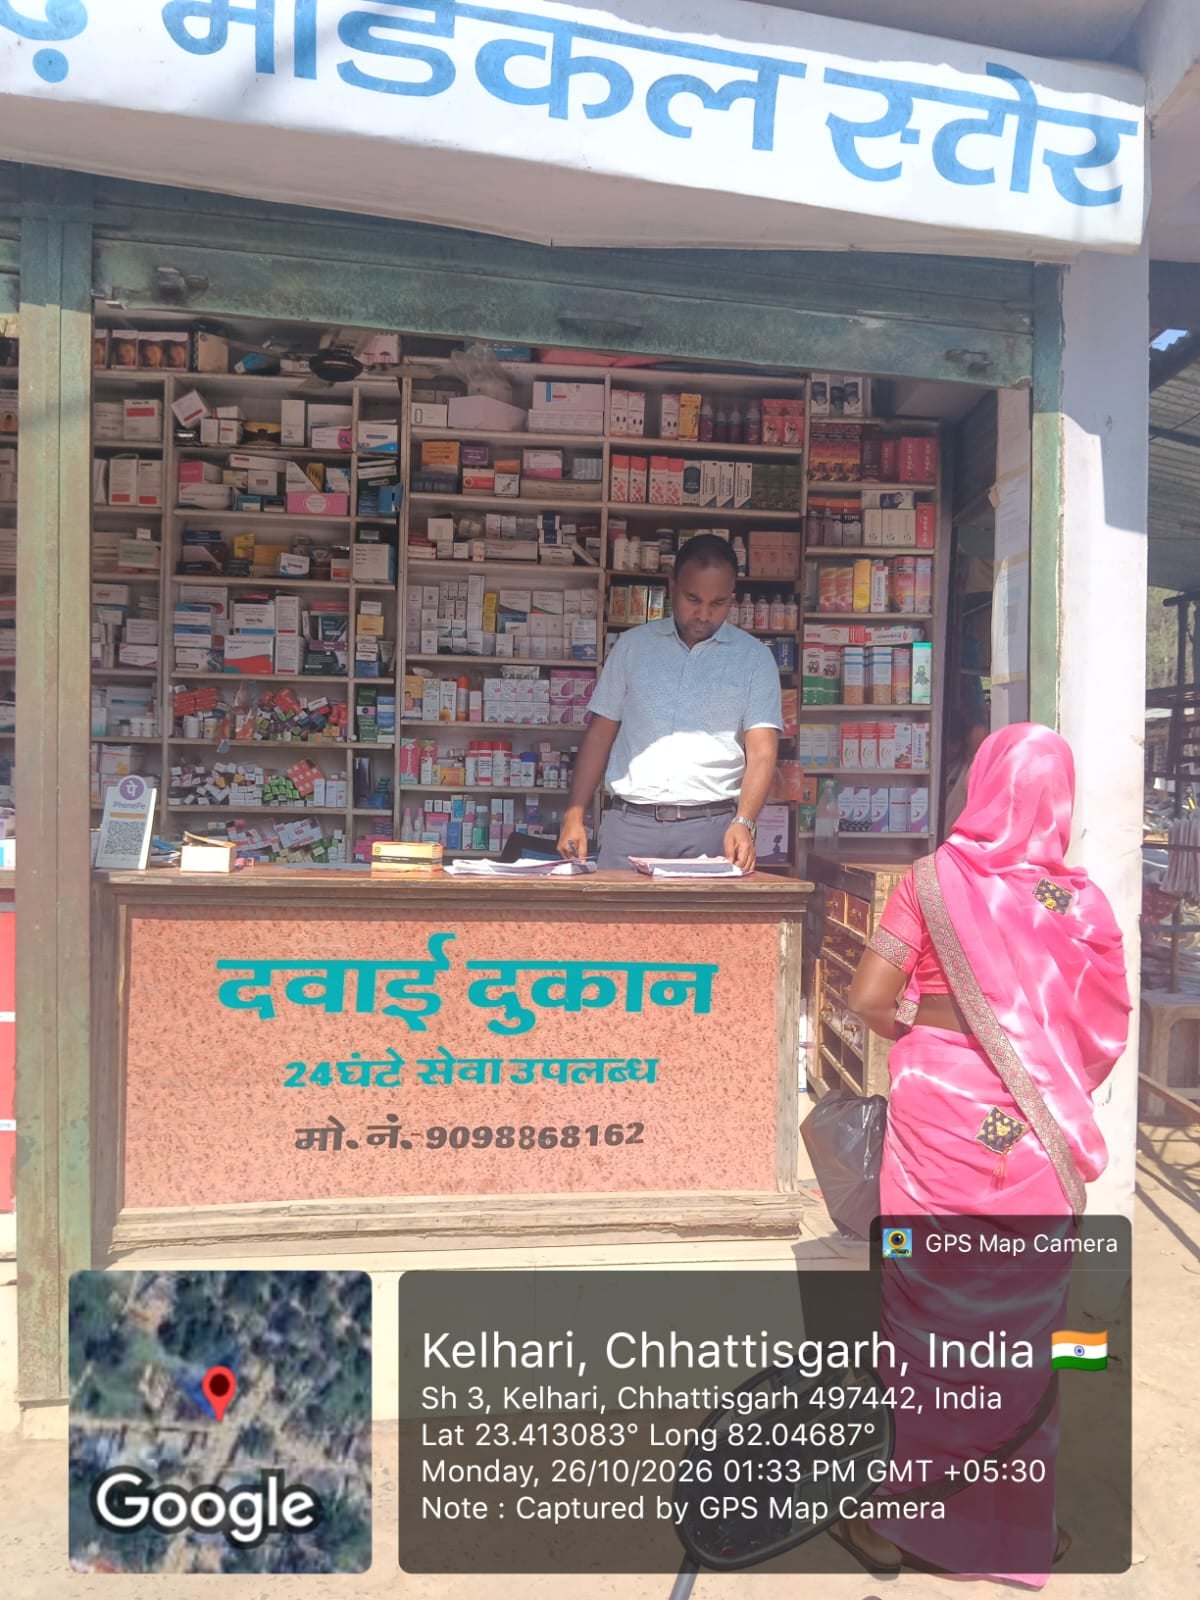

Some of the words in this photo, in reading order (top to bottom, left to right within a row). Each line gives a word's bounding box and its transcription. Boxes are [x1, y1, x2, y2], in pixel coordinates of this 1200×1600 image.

[823, 62, 1139, 208] स्टोर
[112, 800, 146, 810] PhonePe
[216, 933, 456, 1032] दवाई
[466, 959, 719, 1036] दुकान
[416, 1045, 503, 1085] सेवा
[510, 1056, 660, 1085] उपलब्ध
